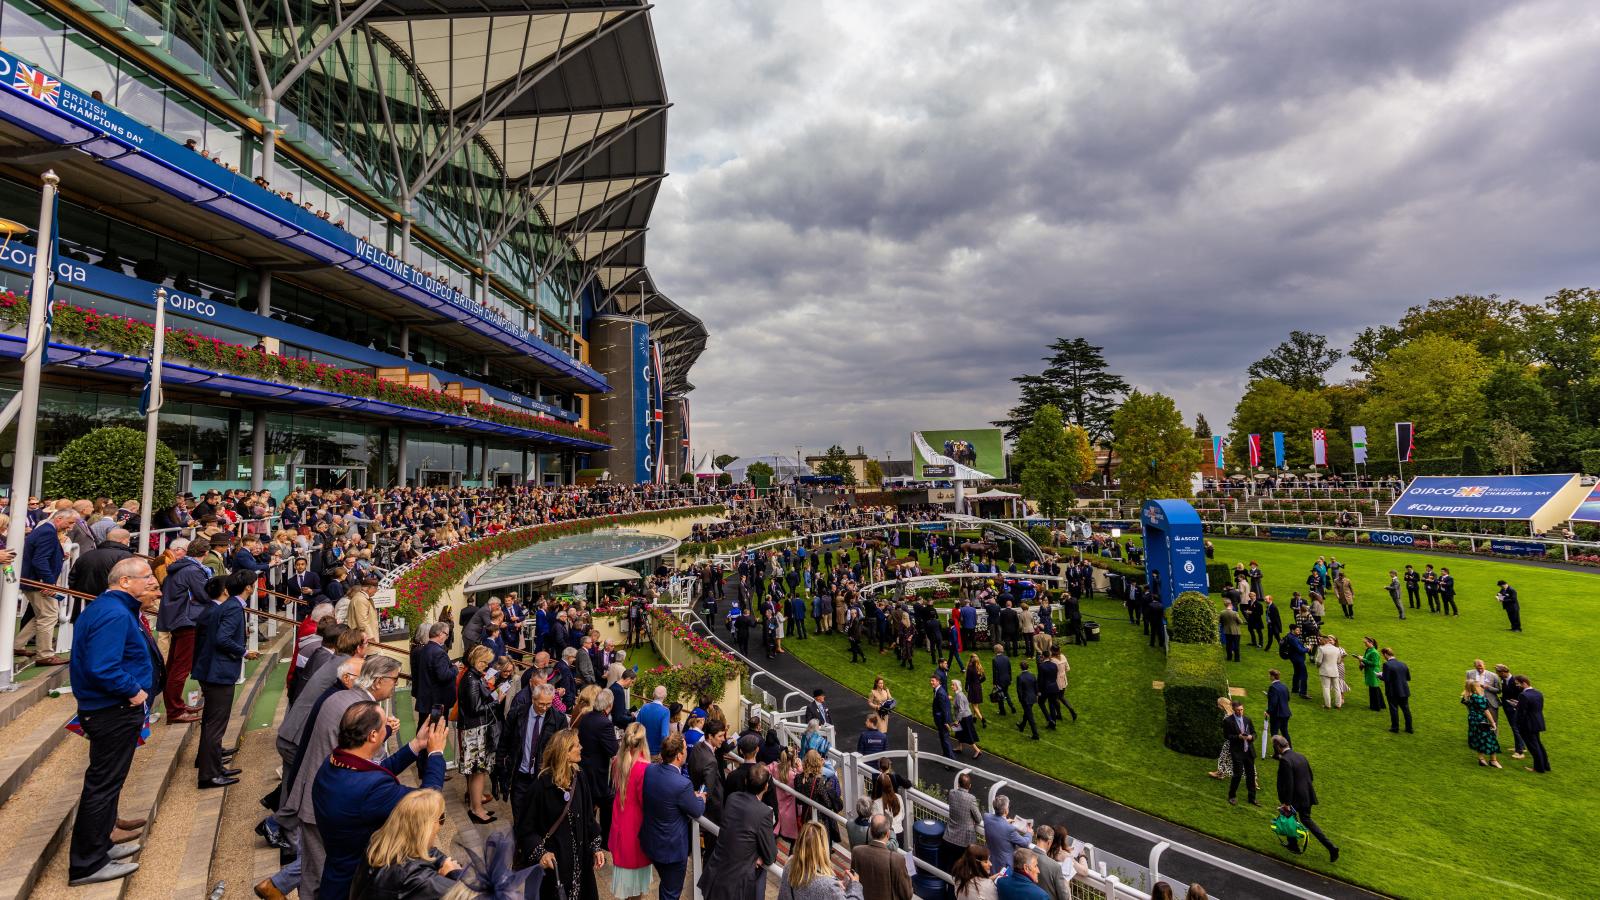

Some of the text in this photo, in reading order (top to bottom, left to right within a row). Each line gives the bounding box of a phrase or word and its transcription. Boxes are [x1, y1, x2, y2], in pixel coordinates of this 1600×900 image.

[63, 89, 108, 118] BRITISH
[62, 99, 144, 144] CHAMPIONS DAY
[355, 238, 530, 340] WELCOME TO QIPCO BRITISH CHAMPIONS DAY
[170, 294, 216, 317] QIPCO
[1410, 487, 1456, 496] QIPCO
[1407, 503, 1522, 515] #ChampionsDay
[1382, 533, 1413, 544] QIPCO
